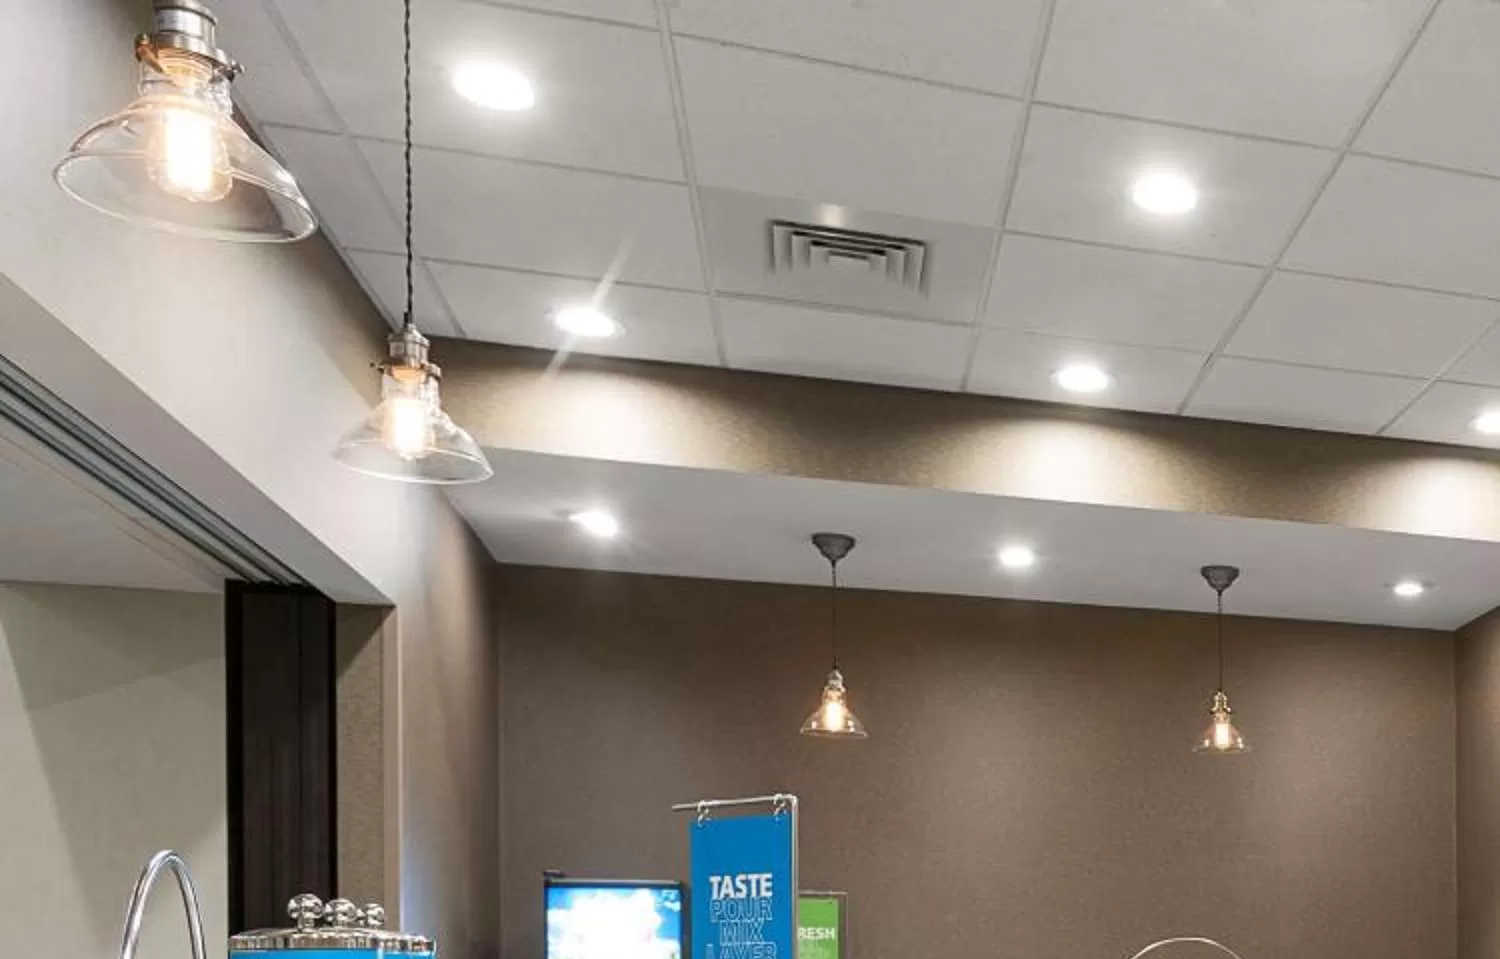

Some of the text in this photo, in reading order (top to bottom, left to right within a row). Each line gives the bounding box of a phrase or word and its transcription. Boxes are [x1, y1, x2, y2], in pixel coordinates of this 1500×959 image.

[709, 872, 773, 900] TASTE
[709, 897, 773, 923] POUR
[796, 926, 836, 941] RESH
